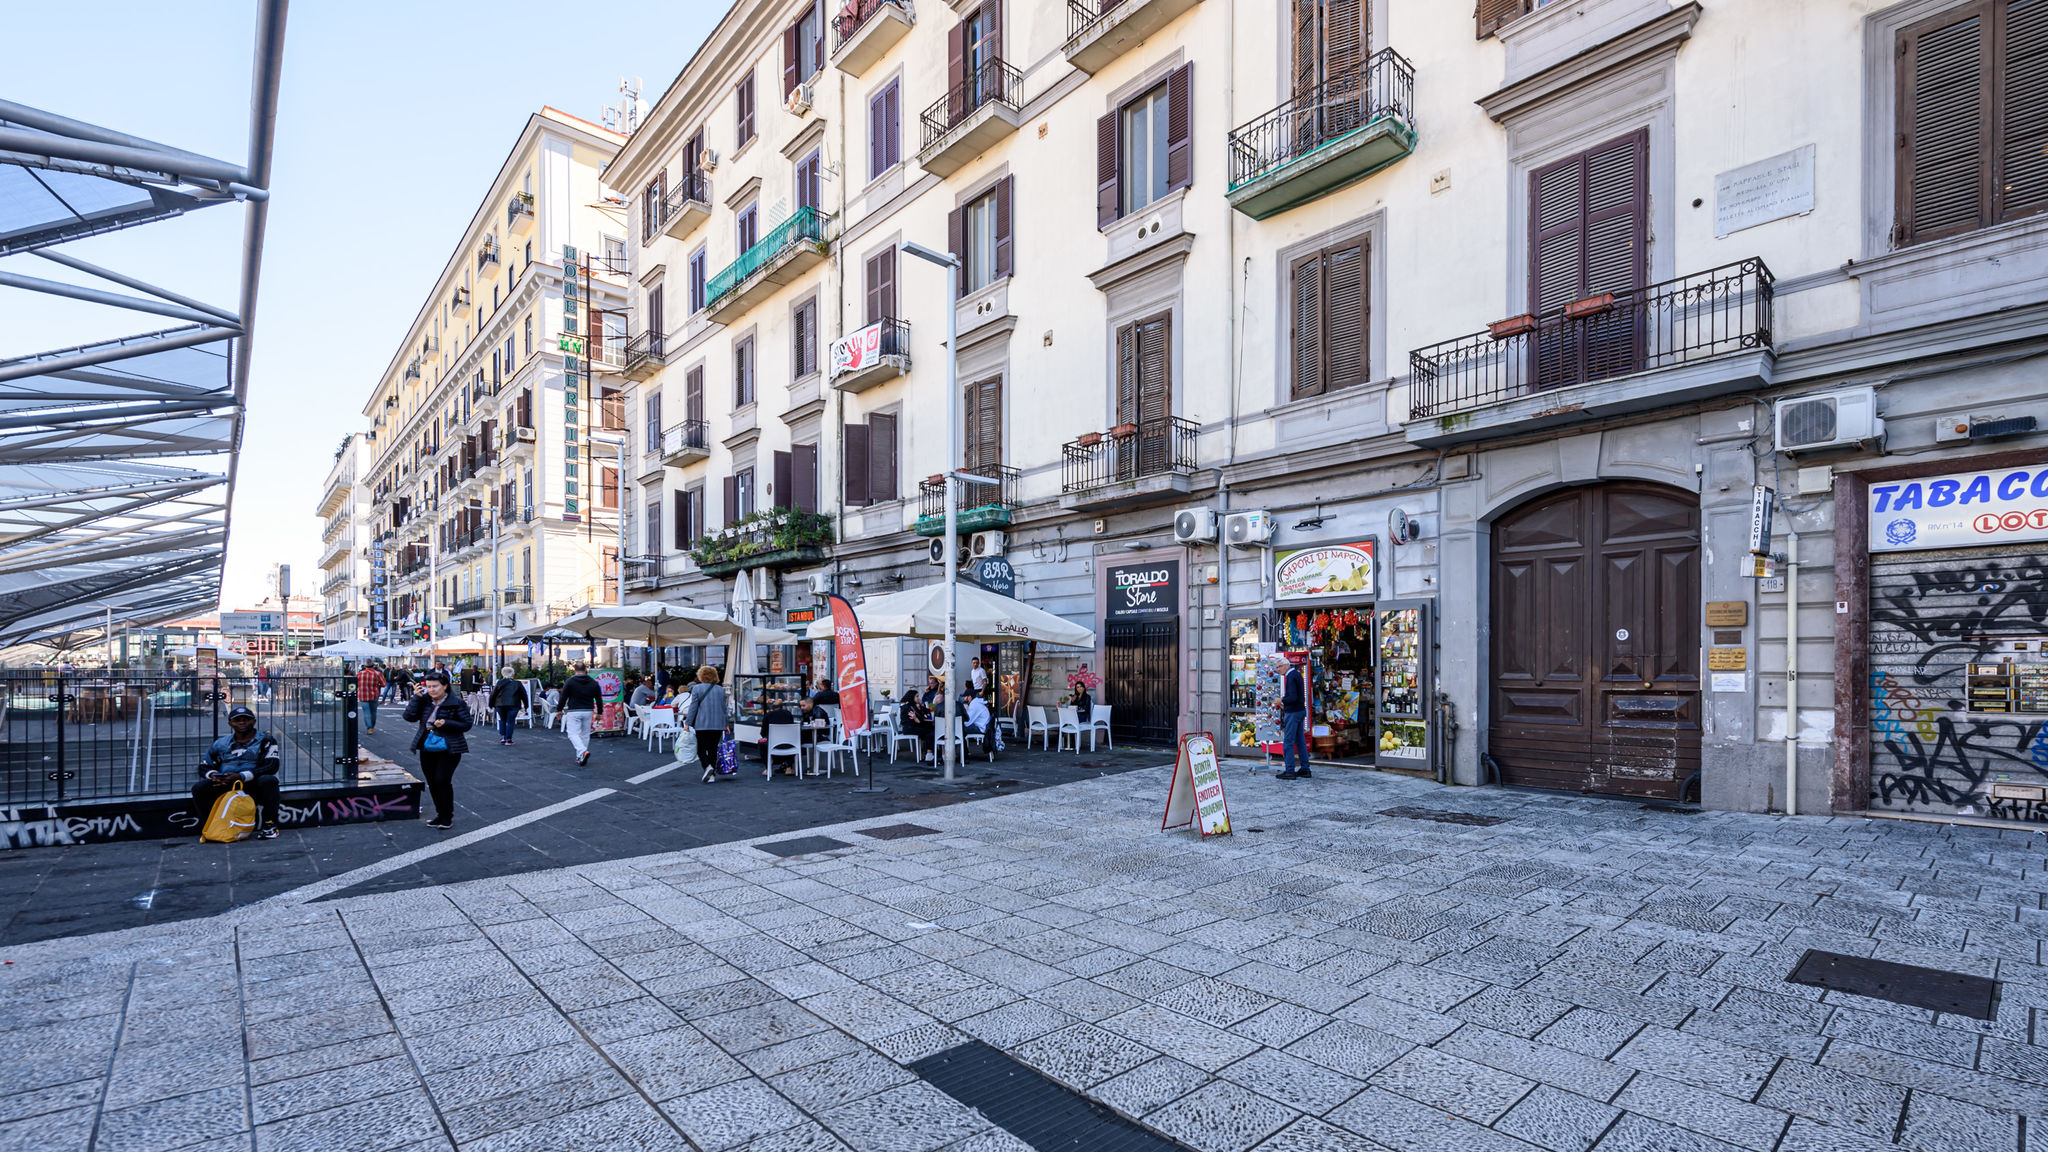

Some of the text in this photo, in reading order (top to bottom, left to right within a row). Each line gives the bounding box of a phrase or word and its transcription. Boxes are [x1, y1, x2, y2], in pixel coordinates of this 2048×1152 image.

[564, 246, 577, 332] HOTEL
[566, 356, 577, 513] VERGILIUS
[1753, 491, 1762, 547] TABACCHI
[983, 561, 1012, 580] BAR
[1282, 550, 1365, 580] SAPORI DI NAPOLI
[1115, 569, 1169, 586] TORALDO
[1281, 581, 1306, 592] ENOTECA
[1767, 579, 1778, 589] 118
[1126, 586, 1157, 607] Store
[1194, 757, 1211, 775] BONTÀ
[1194, 769, 1219, 788] CAMPANE
[1197, 784, 1220, 803] ENOTECA
[1200, 799, 1224, 818] SOUVENIR
